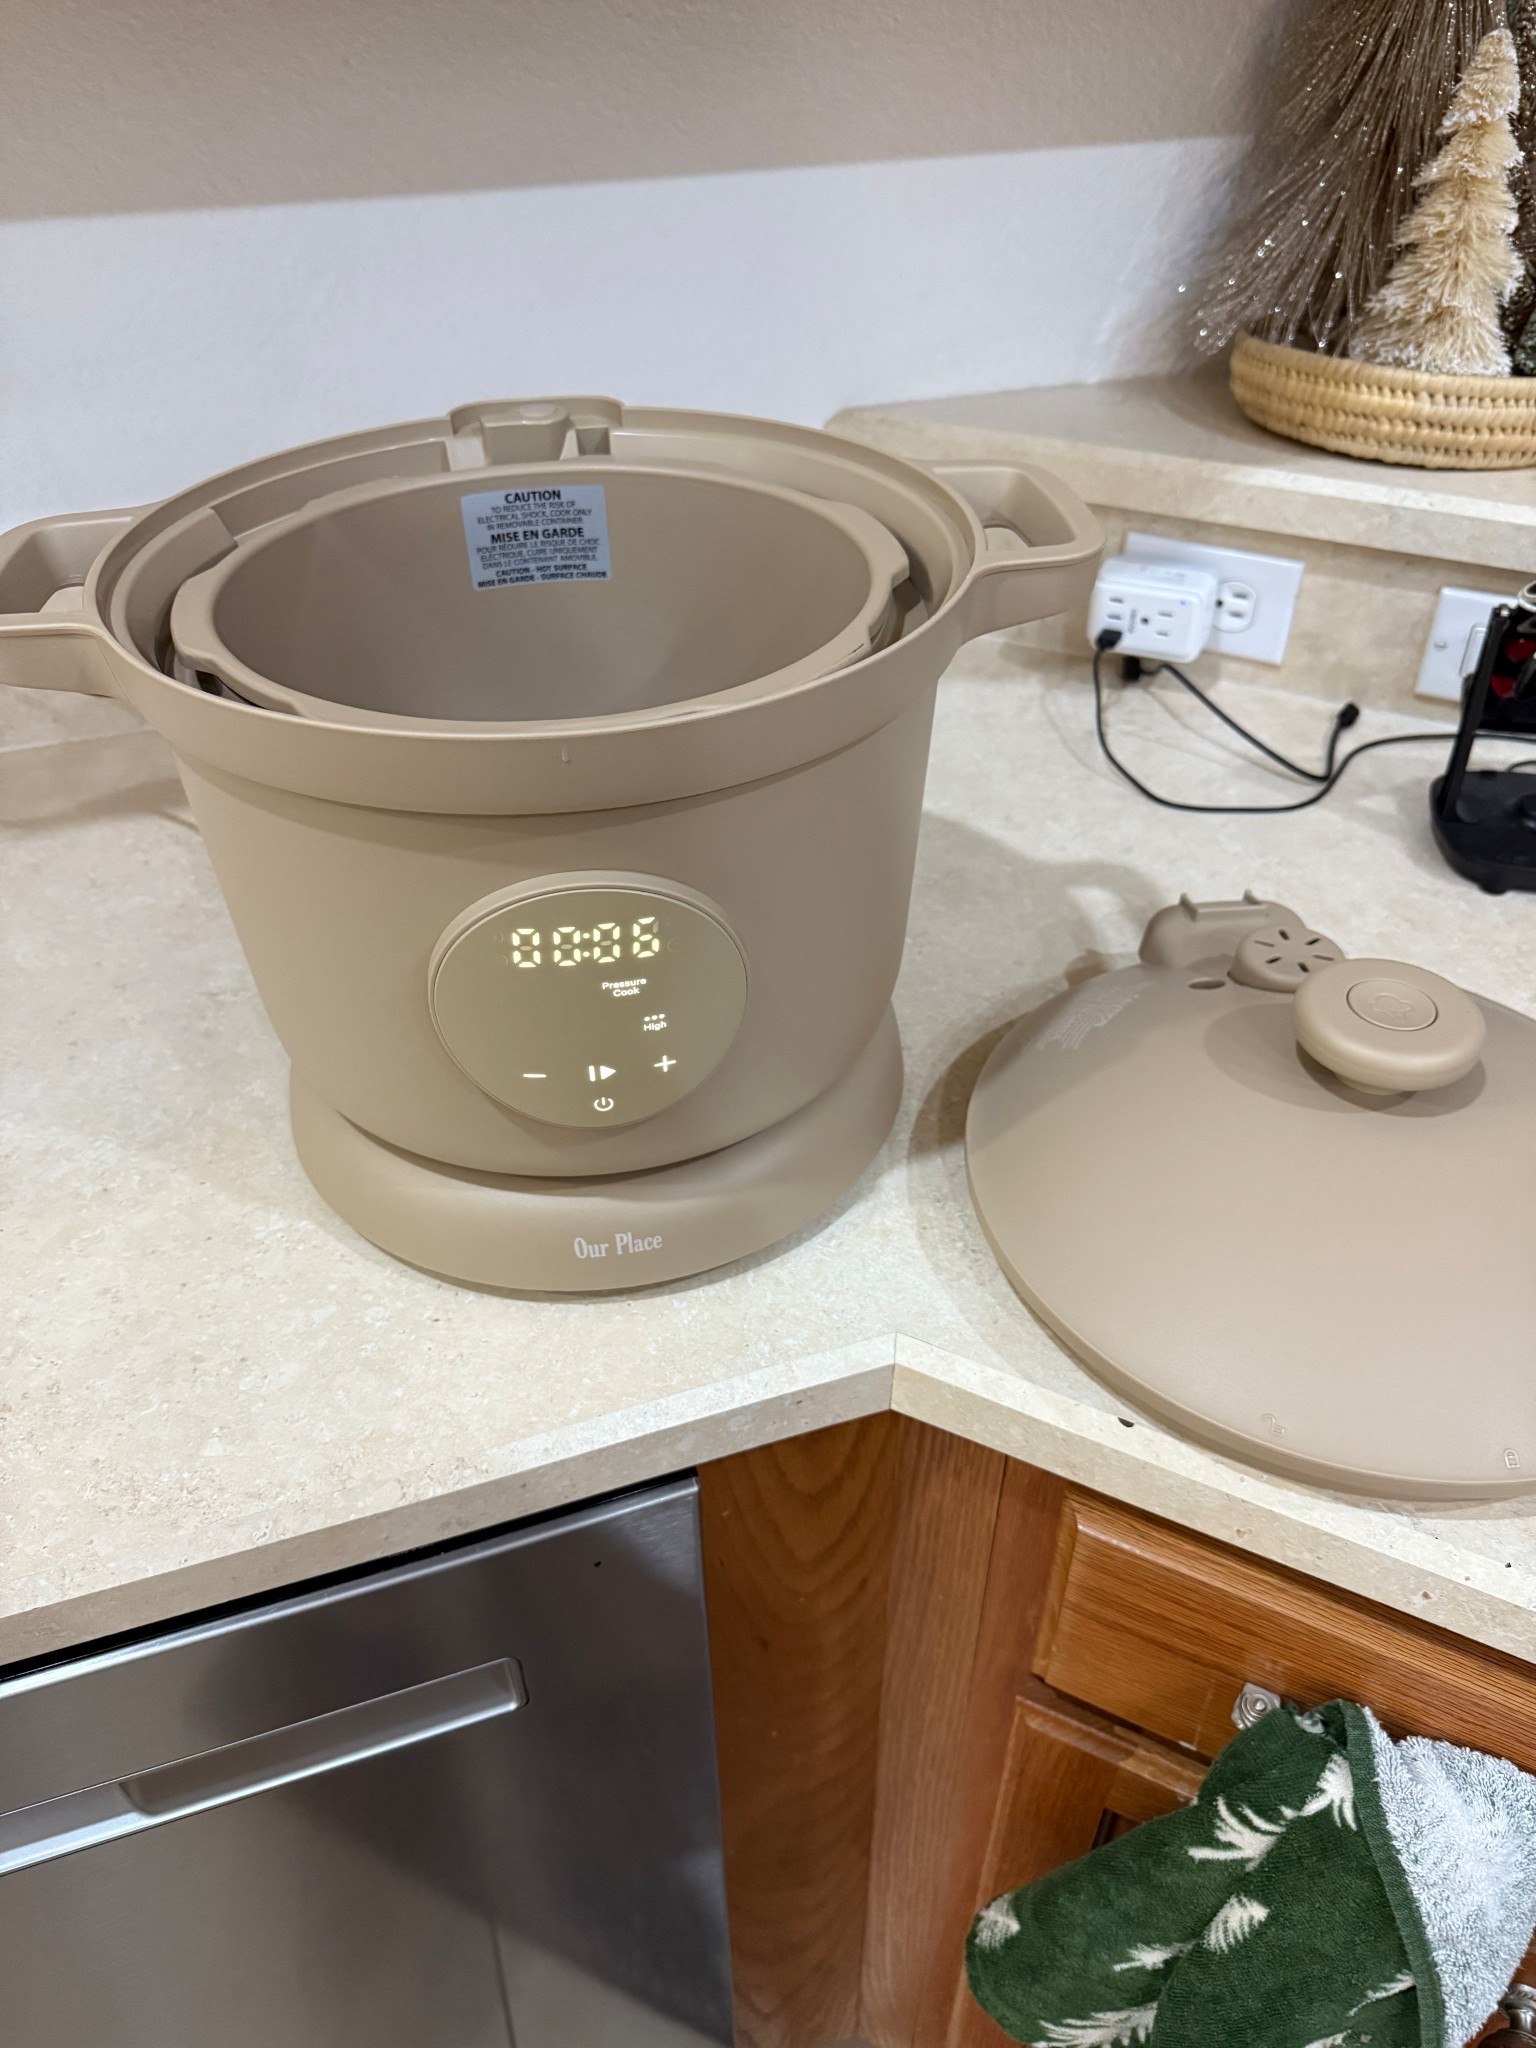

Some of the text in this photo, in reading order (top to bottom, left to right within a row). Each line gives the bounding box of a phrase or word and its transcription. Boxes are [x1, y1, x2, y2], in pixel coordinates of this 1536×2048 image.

[505, 490, 561, 503] CAUTION
[491, 500, 576, 514] TO REDUCE THE RISK OF
[477, 513, 519, 525] ELECTRICAL
[550, 509, 571, 518] COOK
[572, 508, 593, 516] ONLY
[497, 519, 540, 530] REMOVABLE
[490, 527, 584, 544] MISE EN GARDE
[476, 545, 498, 555] POUR
[530, 540, 539, 549] LE
[540, 539, 567, 548] RISQUE
[568, 538, 578, 546] DE
[482, 561, 504, 571] DANS
[504, 558, 513, 567] LE
[495, 567, 530, 578] CAUTION
[536, 565, 552, 573] HOT
[553, 563, 587, 572] SURFACE
[478, 579, 496, 588] MISE
[497, 578, 508, 586] EN
[509, 574, 536, 584] GARDE
[540, 572, 574, 582] SURFACE
[575, 571, 607, 579] CHAUDE
[602, 978, 647, 990] Pressure
[613, 987, 640, 997] Cook
[643, 1021, 667, 1031] High
[573, 1231, 663, 1259] Our Place
